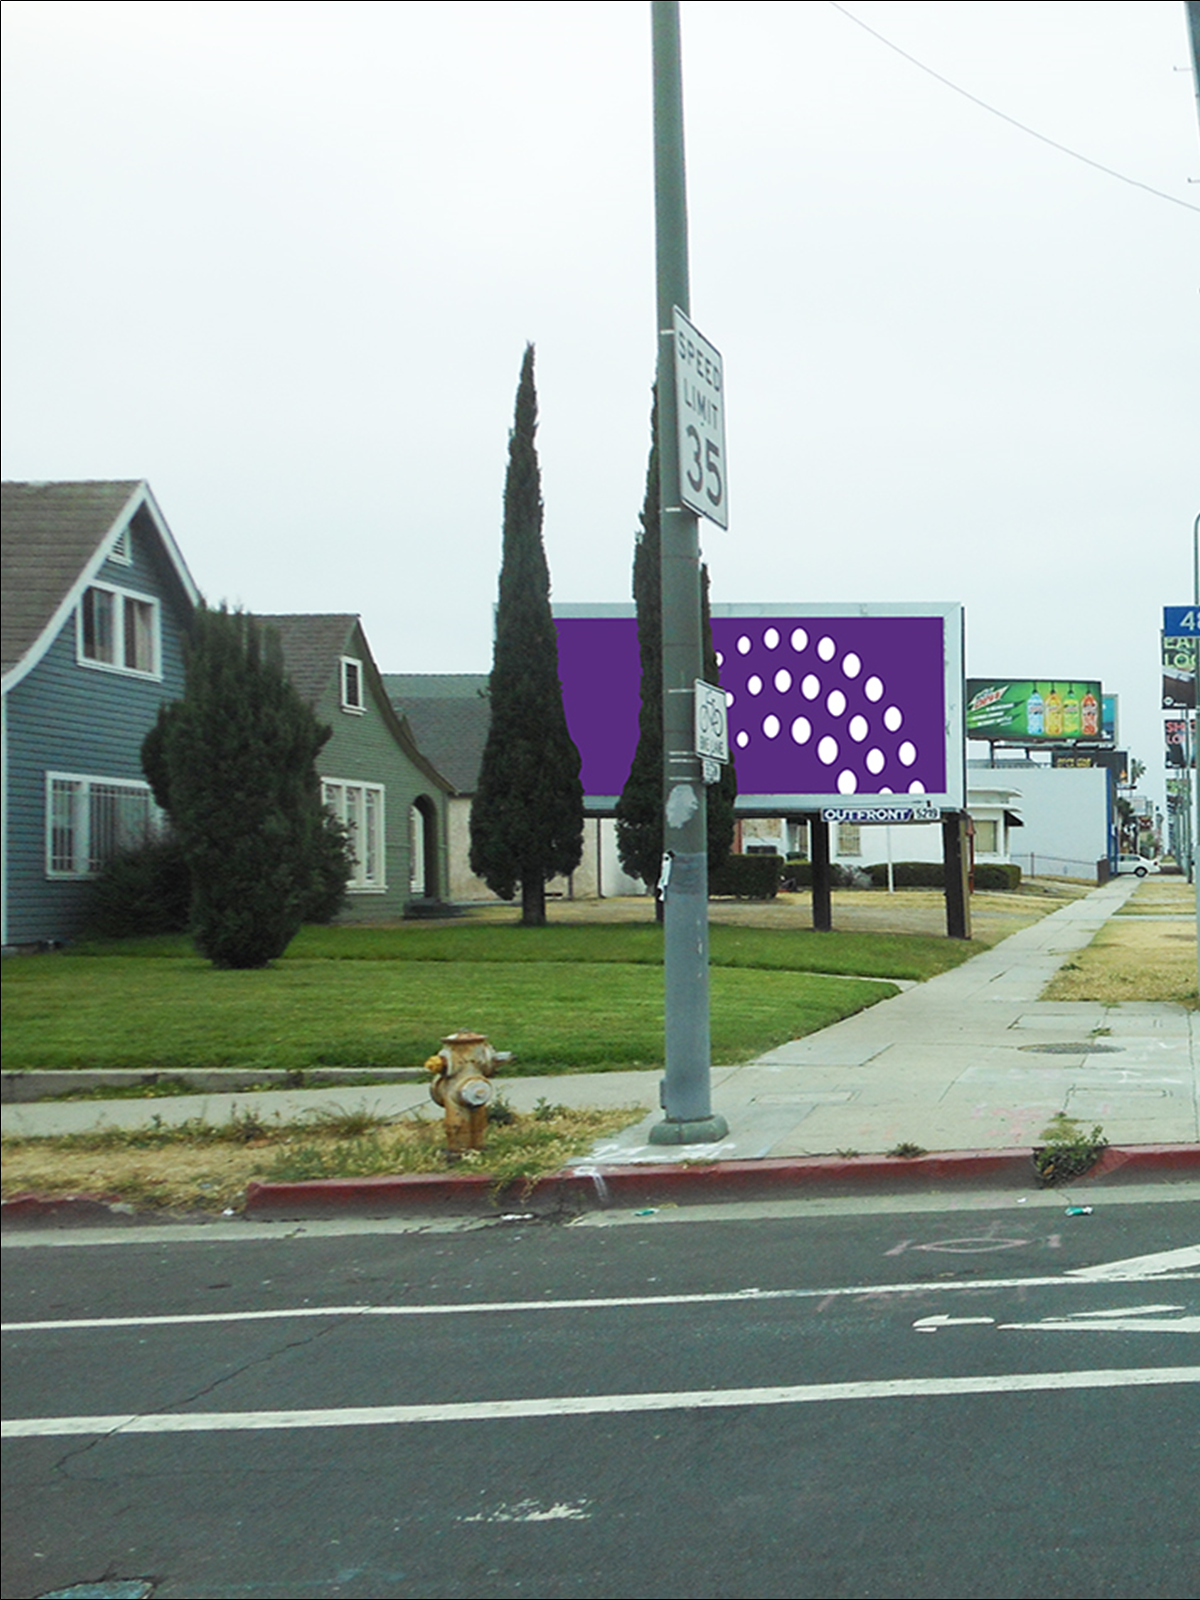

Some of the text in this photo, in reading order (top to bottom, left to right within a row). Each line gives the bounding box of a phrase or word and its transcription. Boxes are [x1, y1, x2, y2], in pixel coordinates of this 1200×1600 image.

[678, 331, 720, 392] SPEED
[683, 378, 719, 431] LIMIT
[686, 424, 723, 507] 35
[825, 809, 908, 820] OUTFRONT
